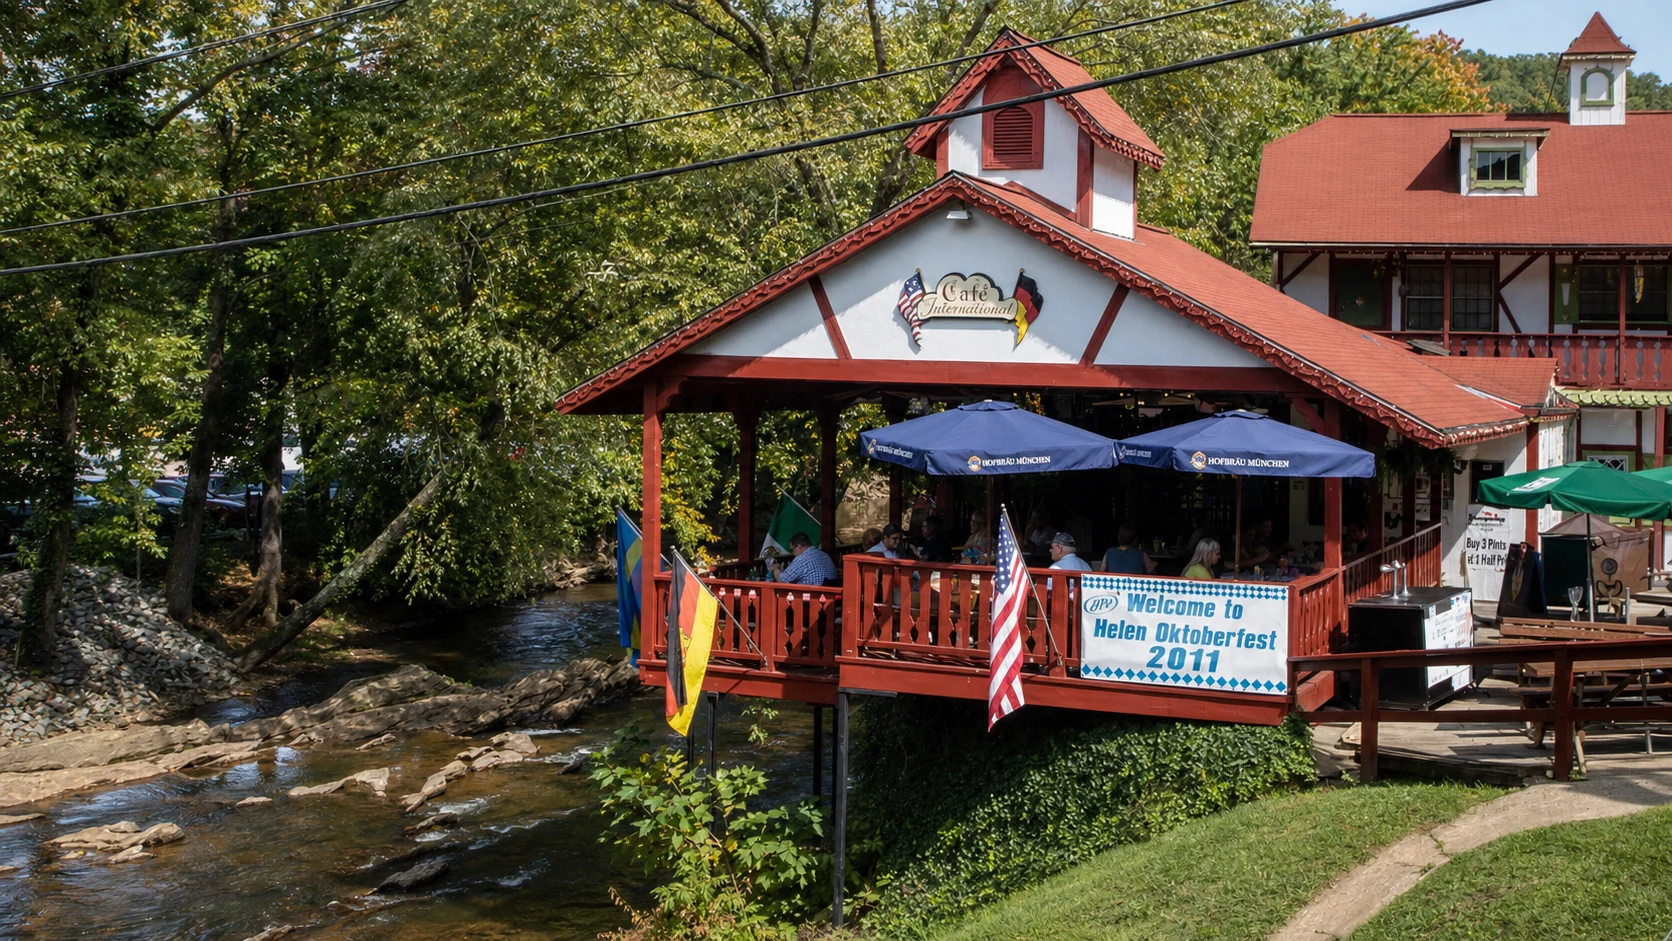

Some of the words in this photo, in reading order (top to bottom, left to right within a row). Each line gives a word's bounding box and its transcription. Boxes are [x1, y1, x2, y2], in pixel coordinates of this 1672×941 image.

[942, 279, 989, 302] Café
[921, 298, 1013, 317] International
[1207, 457, 1246, 466] HOFBRÄU
[1247, 458, 1290, 468] MÜNCHEN
[1466, 537, 1480, 551] Buy
[1481, 539, 1487, 550] 3
[1488, 539, 1507, 551] Pints
[1475, 555, 1479, 565] 1
[1481, 554, 1496, 566] Half
[1127, 593, 1216, 618] Welcome
[1224, 599, 1244, 620] to
[1093, 618, 1147, 641] Helen
[1155, 622, 1278, 650] Oktoberfest
[1146, 645, 1221, 673] 2011
